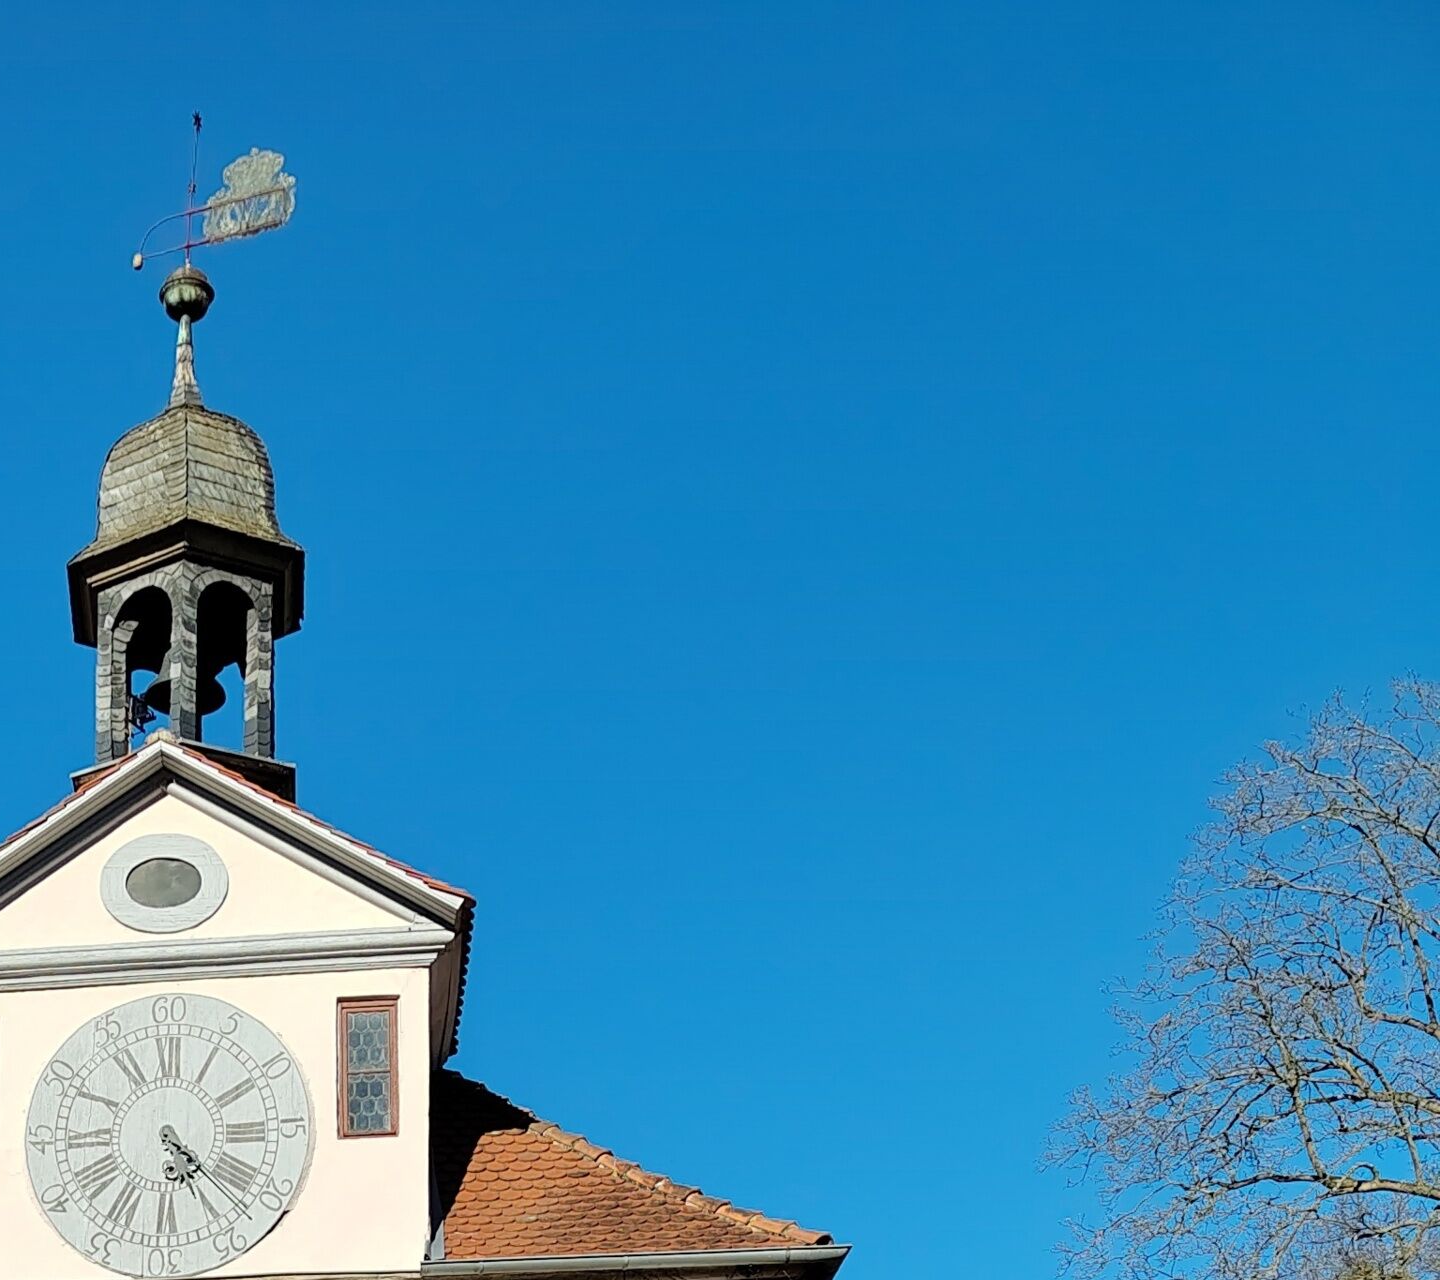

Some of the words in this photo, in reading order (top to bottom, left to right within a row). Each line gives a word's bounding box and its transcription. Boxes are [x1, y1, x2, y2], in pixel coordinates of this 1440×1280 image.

[152, 996, 186, 1023] 60
[219, 1012, 244, 1035] 5
[95, 1011, 122, 1049] 55
[113, 1047, 147, 1093] XI
[154, 1036, 181, 1080] XII
[194, 1046, 219, 1084] I
[261, 1051, 291, 1079] 10
[43, 1059, 75, 1096] 50
[215, 1077, 256, 1109] II
[77, 1083, 119, 1115] X
[28, 1124, 54, 1155] 45
[68, 1128, 111, 1149] IX
[225, 1120, 265, 1144] III
[279, 1115, 307, 1139] 15
[74, 1153, 123, 1205] VIII
[260, 1176, 293, 1212] 20
[41, 1183, 70, 1213] 40
[107, 1180, 143, 1229] VII
[155, 1193, 178, 1236] VI
[196, 1185, 221, 1225] V
[84, 1231, 122, 1265] 35
[212, 1226, 247, 1261] 25
[148, 1248, 182, 1276] 30
